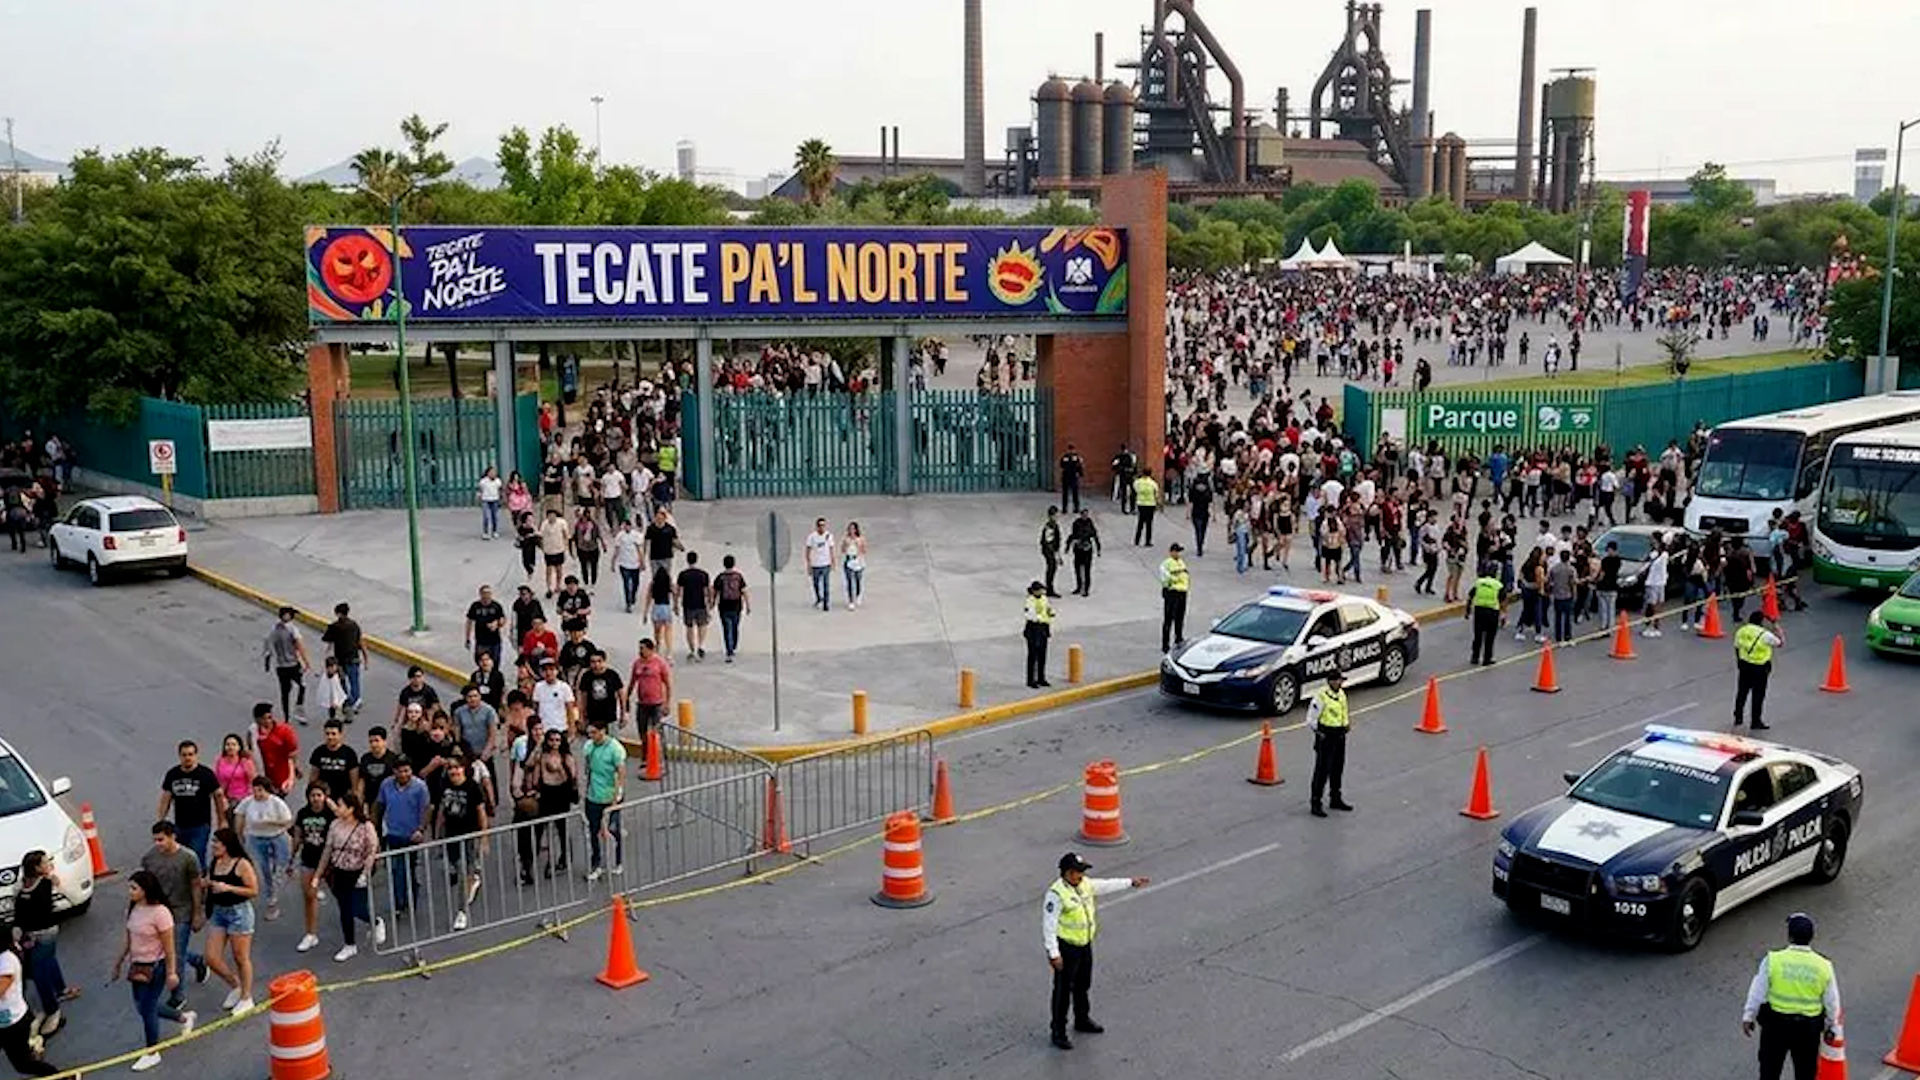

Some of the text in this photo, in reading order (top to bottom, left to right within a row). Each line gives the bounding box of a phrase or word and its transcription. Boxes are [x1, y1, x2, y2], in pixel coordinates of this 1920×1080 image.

[425, 232, 485, 261] TECATE
[534, 242, 709, 305] TECATE
[826, 241, 969, 303] NORTE
[422, 266, 508, 311] NORTE
[1428, 404, 1518, 433] Parque
[1614, 902, 1647, 917] 1010
